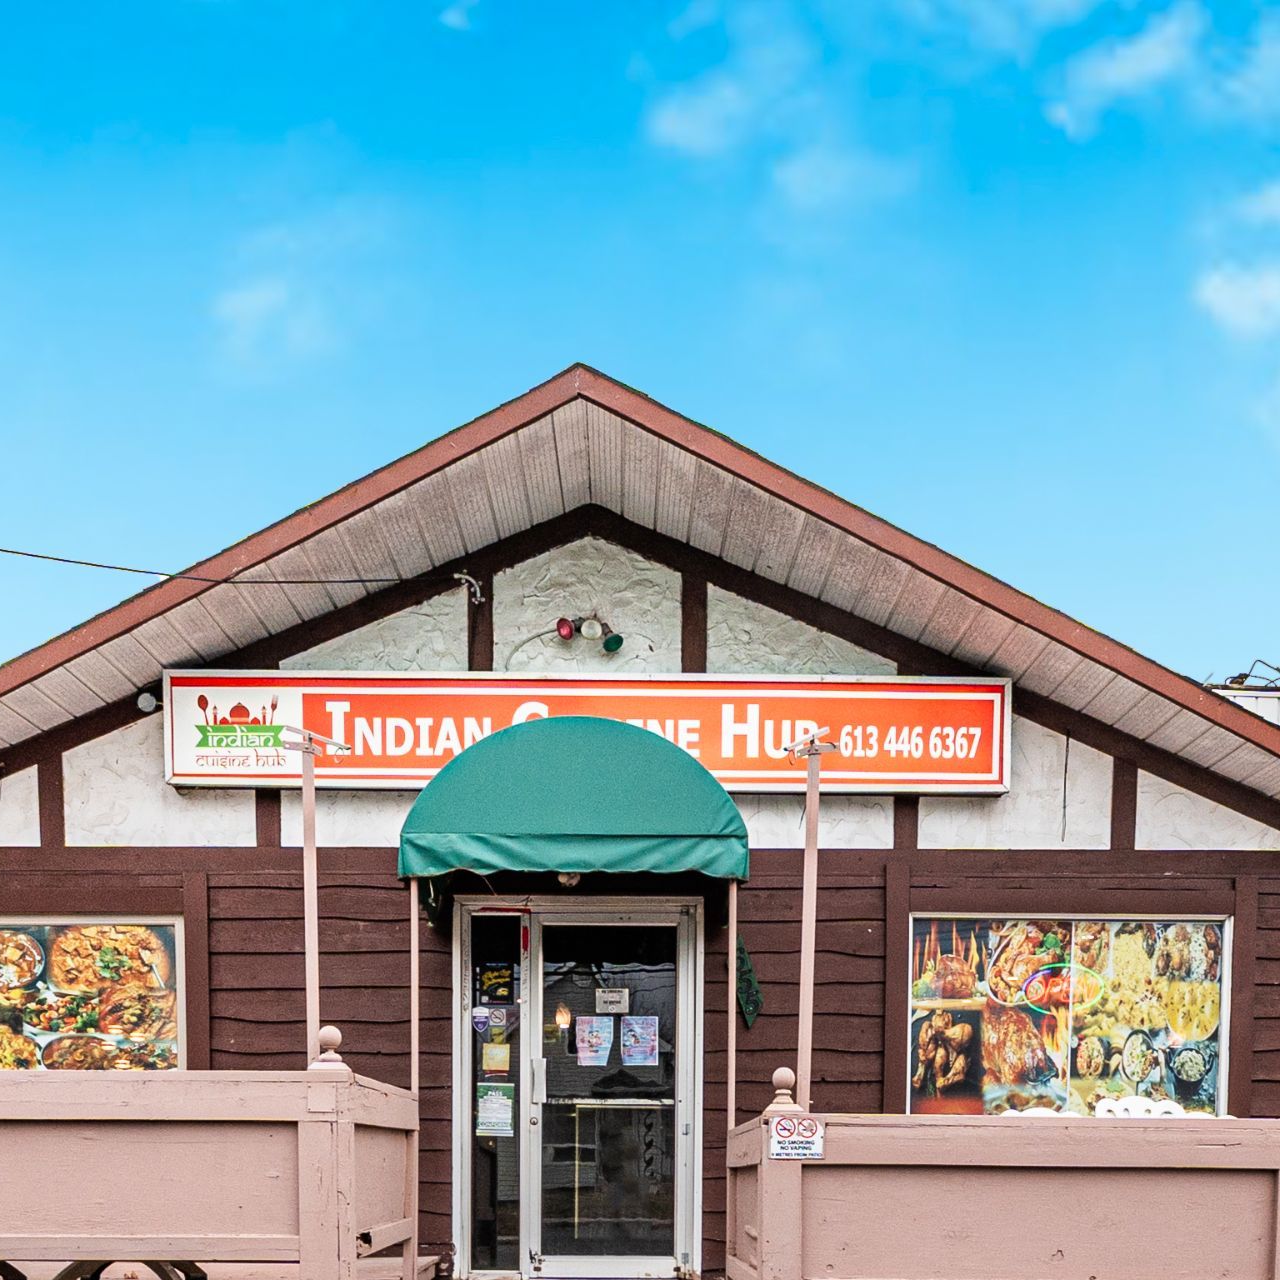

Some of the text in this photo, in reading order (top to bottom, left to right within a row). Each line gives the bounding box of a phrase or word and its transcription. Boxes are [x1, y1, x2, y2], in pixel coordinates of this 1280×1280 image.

[206, 724, 275, 748] indian
[839, 724, 982, 759] 613 446 6367
[195, 748, 287, 769] cuisine hub
